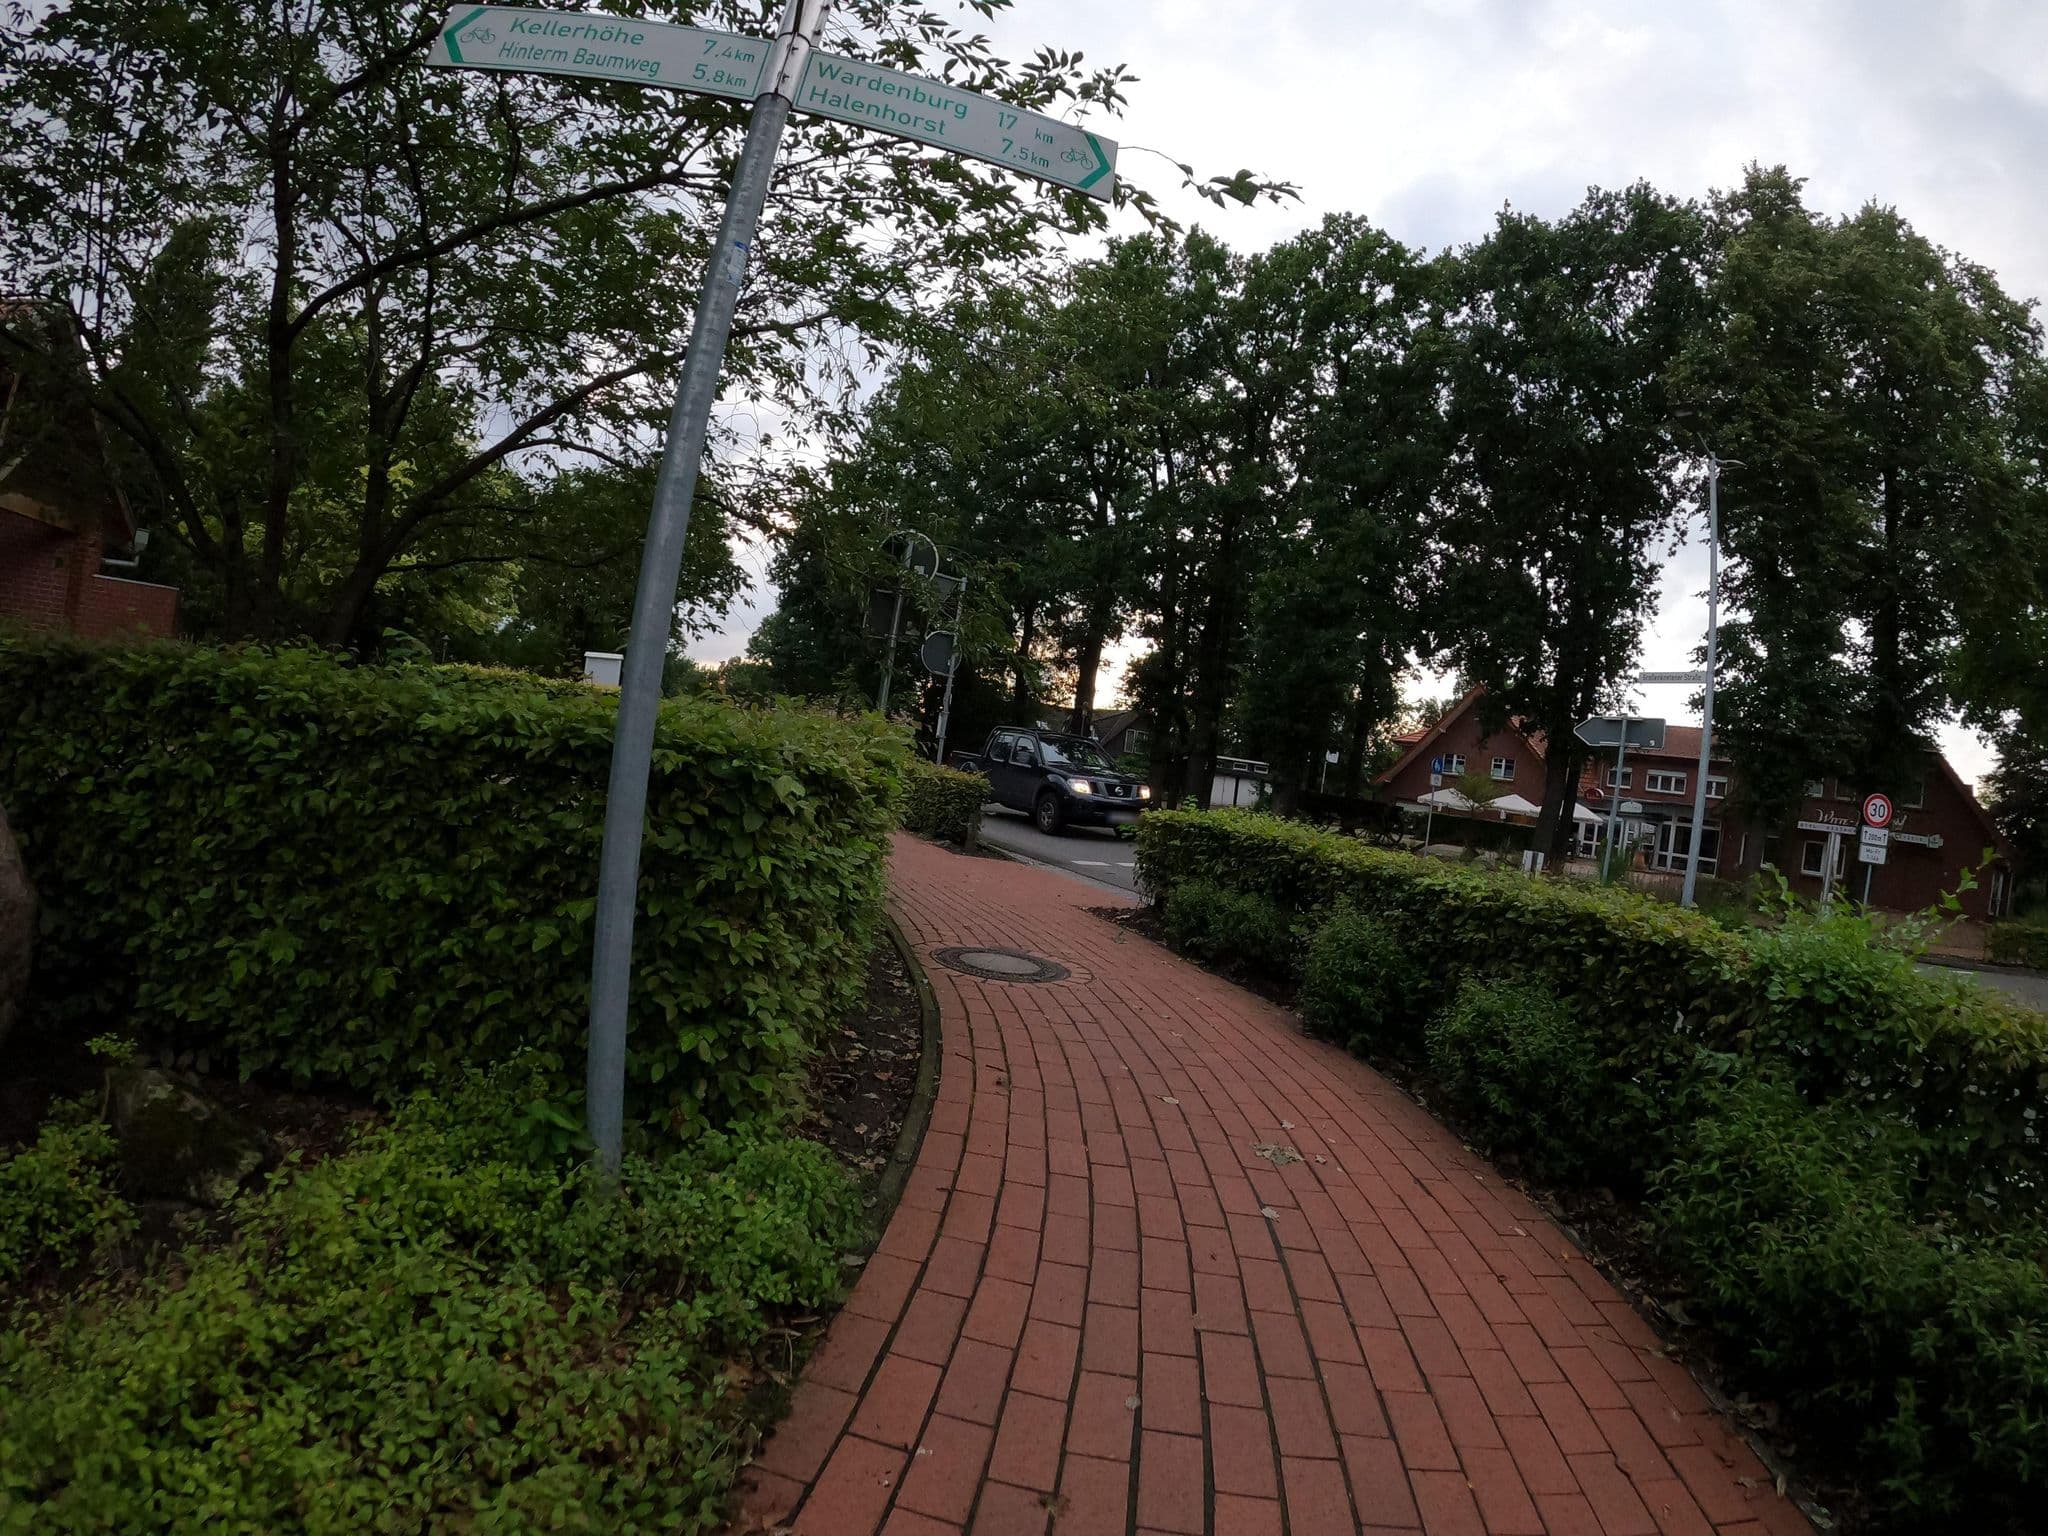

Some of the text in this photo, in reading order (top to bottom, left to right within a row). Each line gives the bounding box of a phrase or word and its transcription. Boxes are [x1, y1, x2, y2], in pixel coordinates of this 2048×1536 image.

[509, 17, 644, 45] Kellerhöhe
[498, 41, 568, 62] Hinterm
[573, 47, 661, 77] Baumweg
[809, 85, 947, 136] Halenhorst
[818, 61, 1054, 145] Wardenburg 17 km
[1869, 803, 1886, 819] 30
